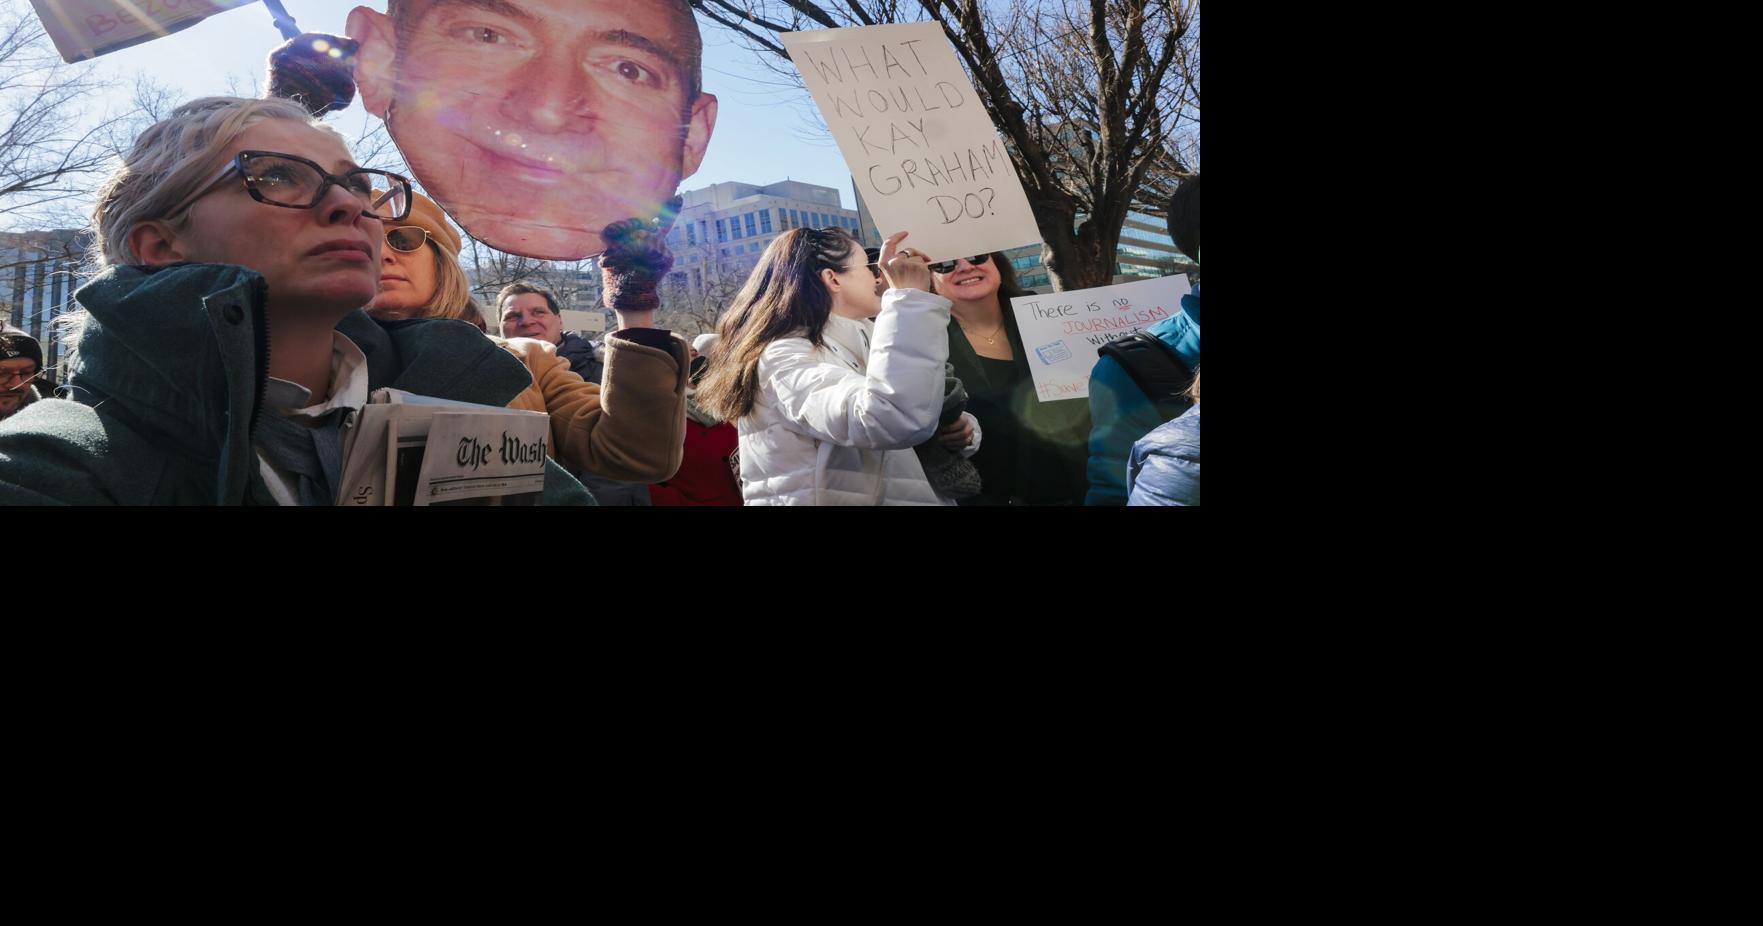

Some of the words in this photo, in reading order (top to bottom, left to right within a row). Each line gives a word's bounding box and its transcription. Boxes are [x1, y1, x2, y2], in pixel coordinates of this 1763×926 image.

[804, 39, 928, 85] WHAT
[827, 81, 965, 118] WOULD
[852, 117, 930, 156] KAY
[868, 139, 1011, 196] GRAHAM
[926, 187, 996, 225] DO?
[1023, 302, 1078, 320] There
[1086, 301, 1102, 312] is
[1112, 298, 1129, 307] no
[1063, 306, 1169, 332] JOURNALISM
[456, 436, 492, 472] The
[499, 430, 547, 468] Wash
